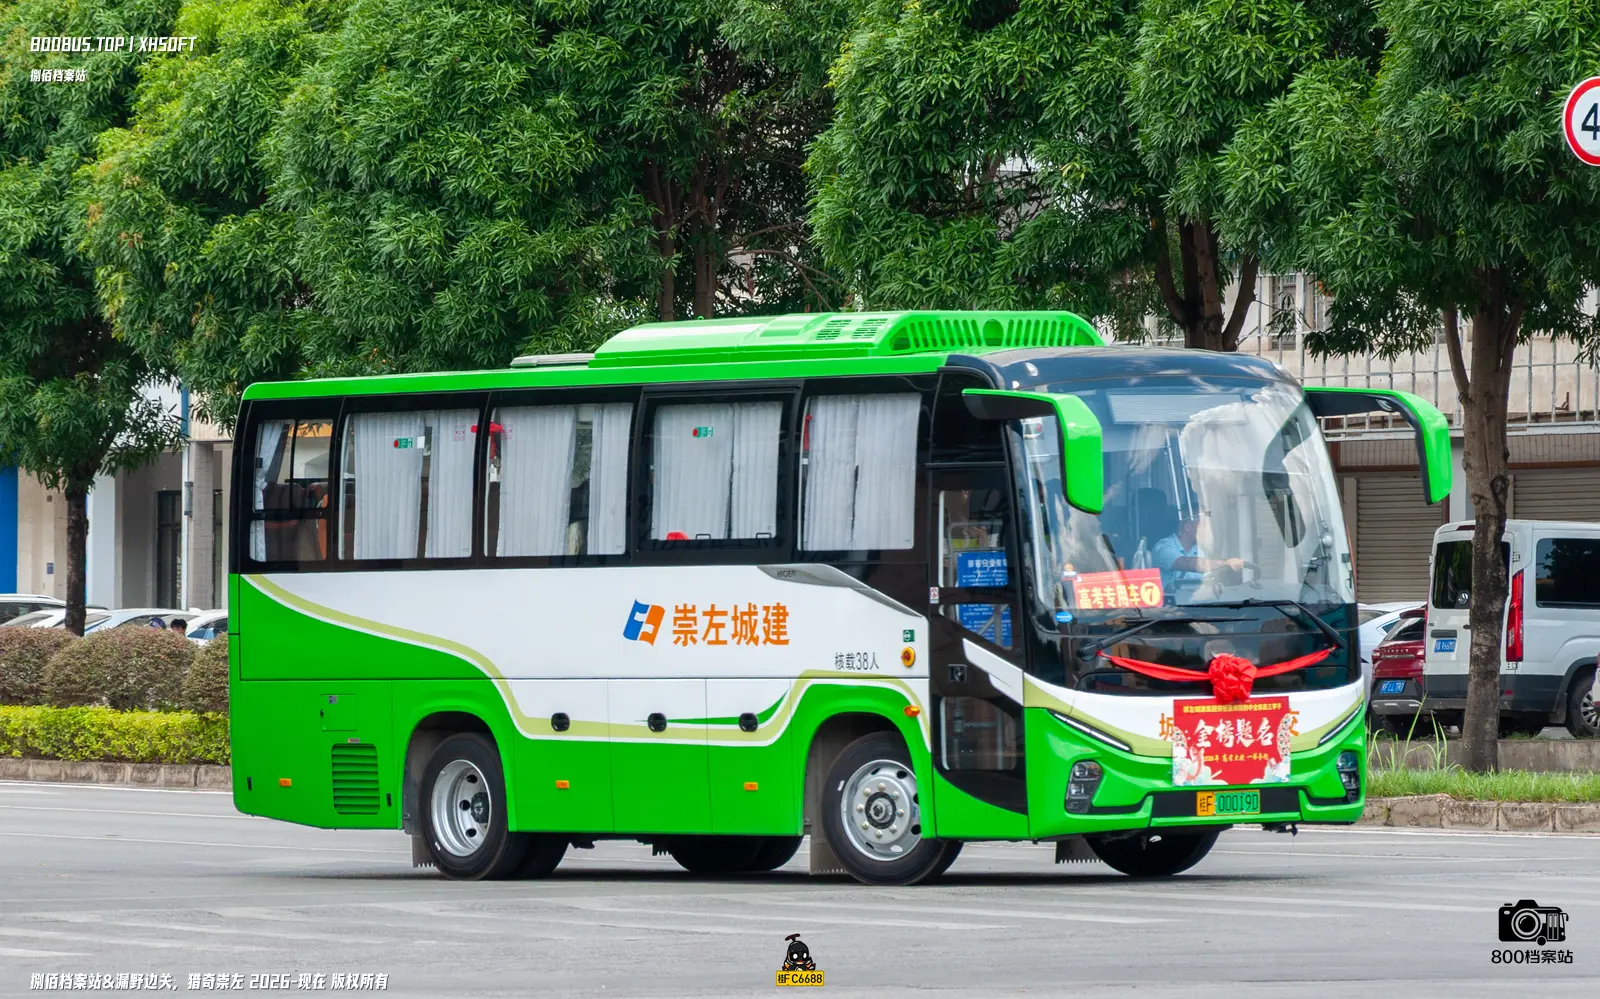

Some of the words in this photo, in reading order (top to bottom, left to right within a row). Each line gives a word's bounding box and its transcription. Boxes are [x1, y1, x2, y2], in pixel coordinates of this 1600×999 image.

[1581, 103, 1600, 140] 4
[1078, 583, 1141, 609] 高考专用车
[672, 602, 790, 647] 崇左城建
[834, 652, 880, 670] 核载38人
[1192, 717, 1275, 748] 金榜题名
[1218, 794, 1259, 811] 00019D
